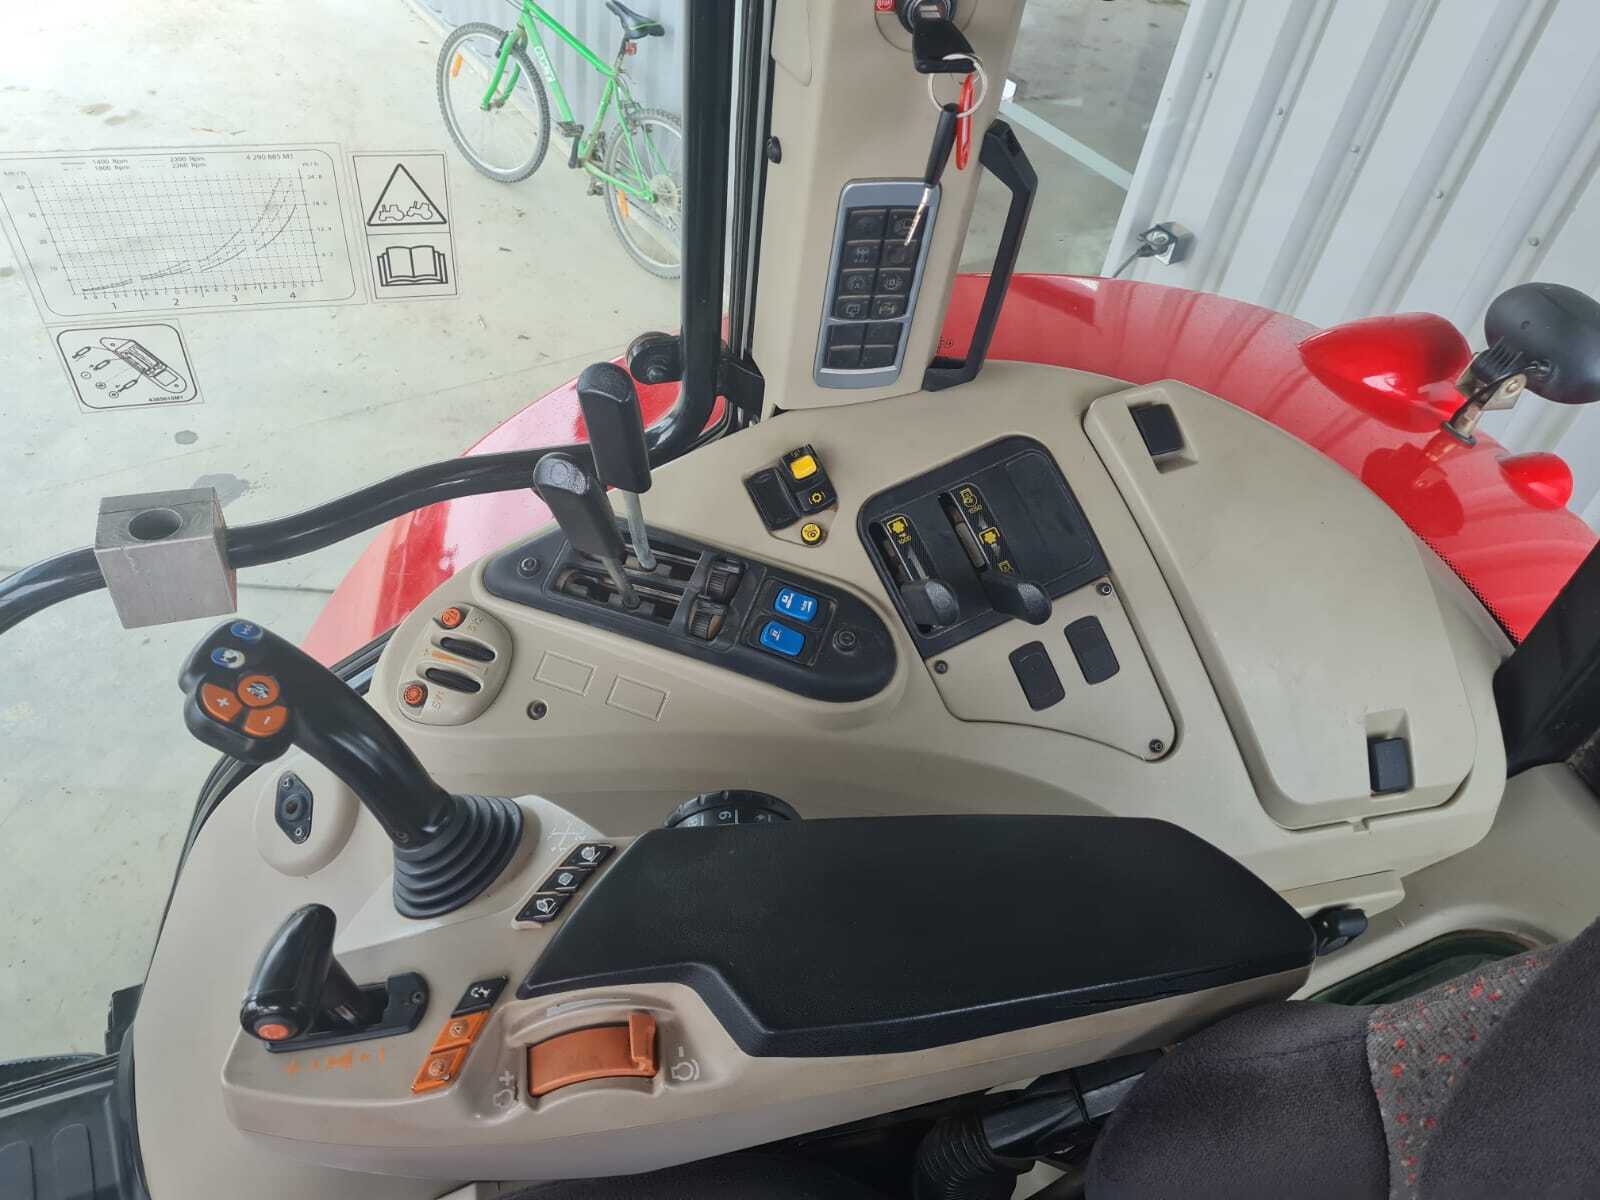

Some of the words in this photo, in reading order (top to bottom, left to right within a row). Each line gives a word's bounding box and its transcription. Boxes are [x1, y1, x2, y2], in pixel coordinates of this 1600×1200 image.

[231, 295, 238, 303] 3
[289, 291, 297, 299] 4
[173, 298, 179, 306] 2
